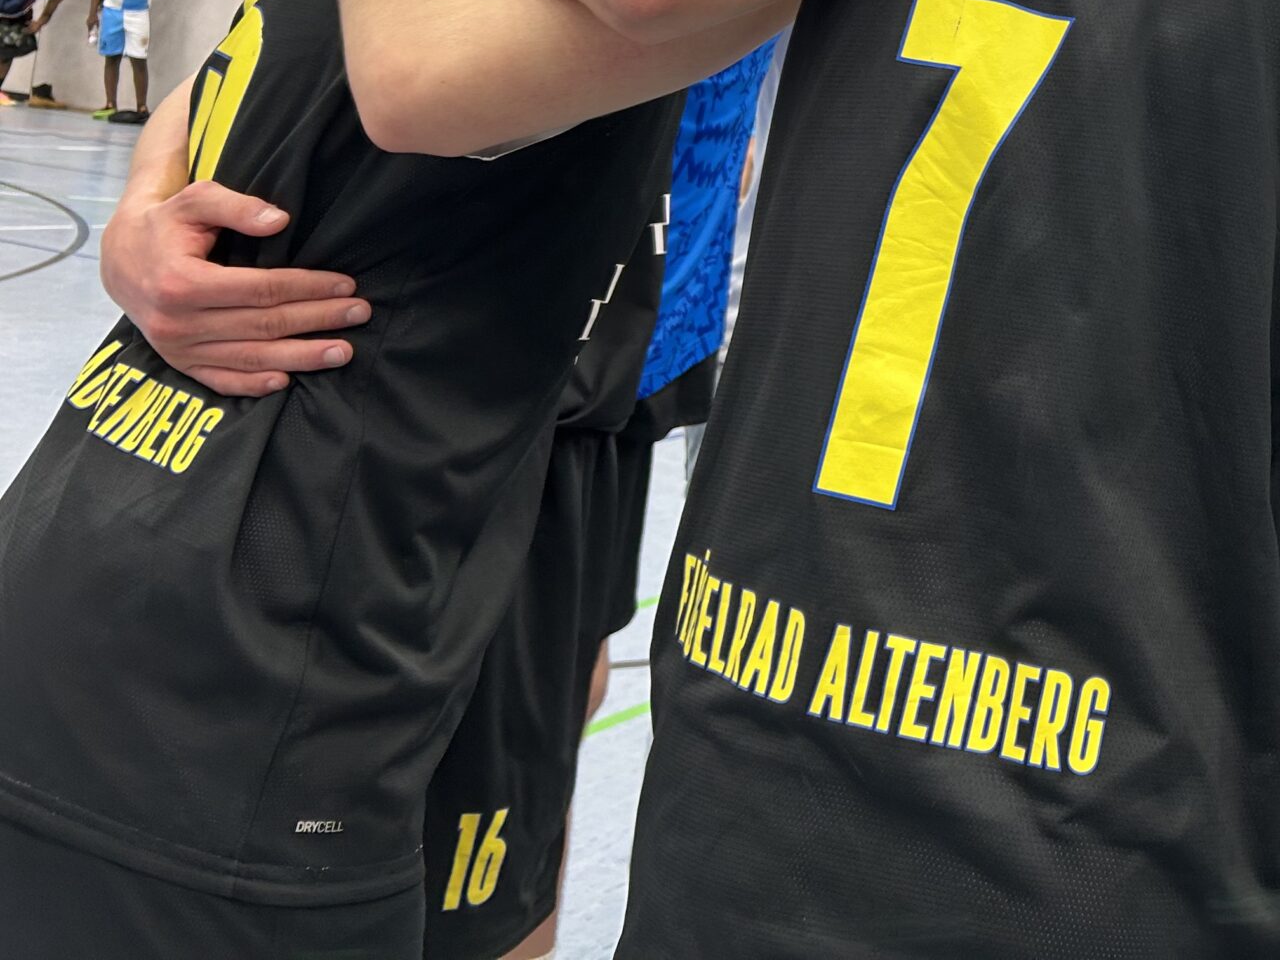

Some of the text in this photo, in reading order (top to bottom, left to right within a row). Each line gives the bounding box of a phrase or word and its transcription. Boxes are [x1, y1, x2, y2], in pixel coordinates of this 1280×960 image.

[806, 623, 1112, 776] ALTENBERG
[295, 820, 343, 833] DRYCELL
[443, 808, 509, 911] 16
